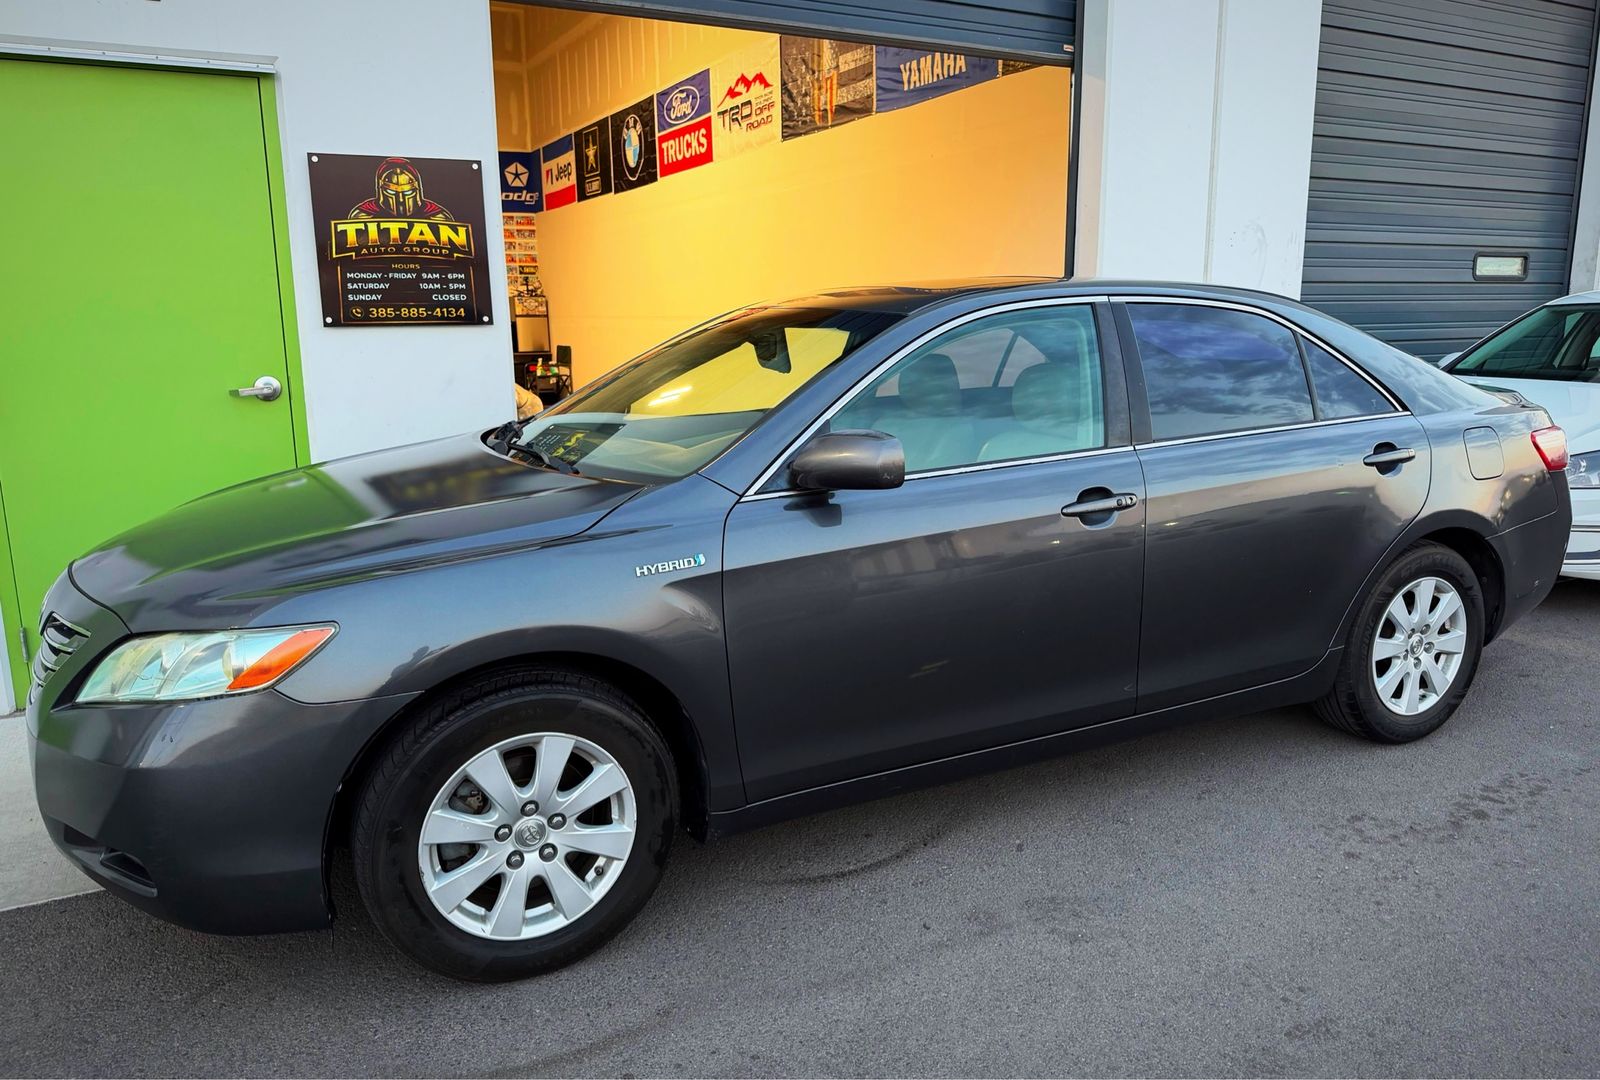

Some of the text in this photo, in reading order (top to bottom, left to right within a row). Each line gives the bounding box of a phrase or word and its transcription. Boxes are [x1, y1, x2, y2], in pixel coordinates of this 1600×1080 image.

[900, 52, 967, 91] YAMAHA
[671, 92, 692, 120] Ford
[717, 100, 775, 131] TRD OFF
[746, 115, 772, 131] ROAD
[662, 128, 707, 165] TRUCKS
[555, 162, 572, 181] Jeep
[337, 222, 469, 251] TITAN
[360, 246, 449, 255] AUTO GROUP
[368, 307, 465, 318] 385-885-4134
[635, 557, 696, 577] HYBRID
